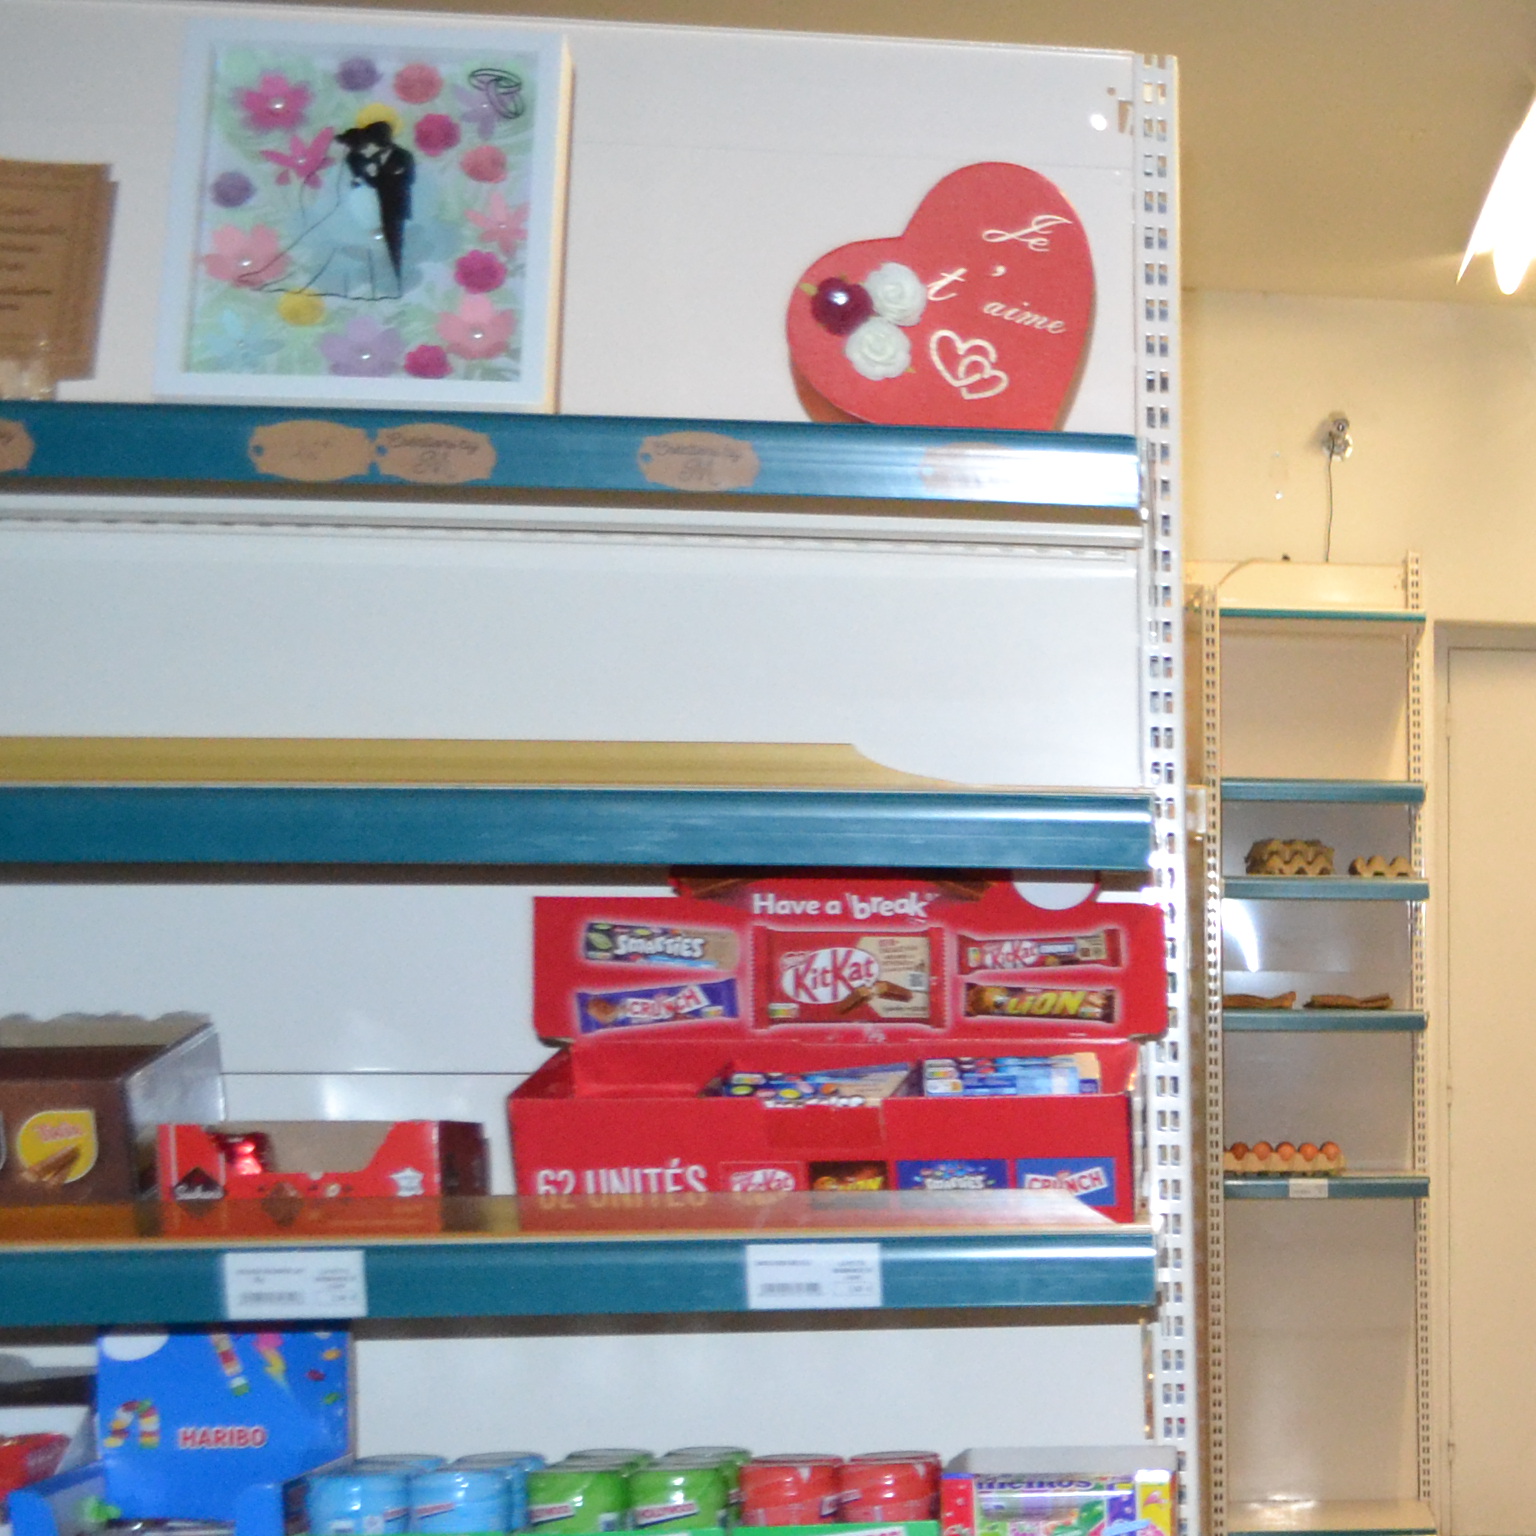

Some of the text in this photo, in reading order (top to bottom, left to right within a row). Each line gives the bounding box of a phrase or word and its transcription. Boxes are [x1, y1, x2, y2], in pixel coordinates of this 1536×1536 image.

[982, 214, 1073, 252] Je
[753, 893, 820, 914] Have
[824, 899, 843, 914] a
[792, 948, 875, 1003] KitKat
[536, 1169, 577, 1210] 62
[584, 1157, 708, 1208] UNITÉS
[178, 1426, 268, 1450] HARIBO
